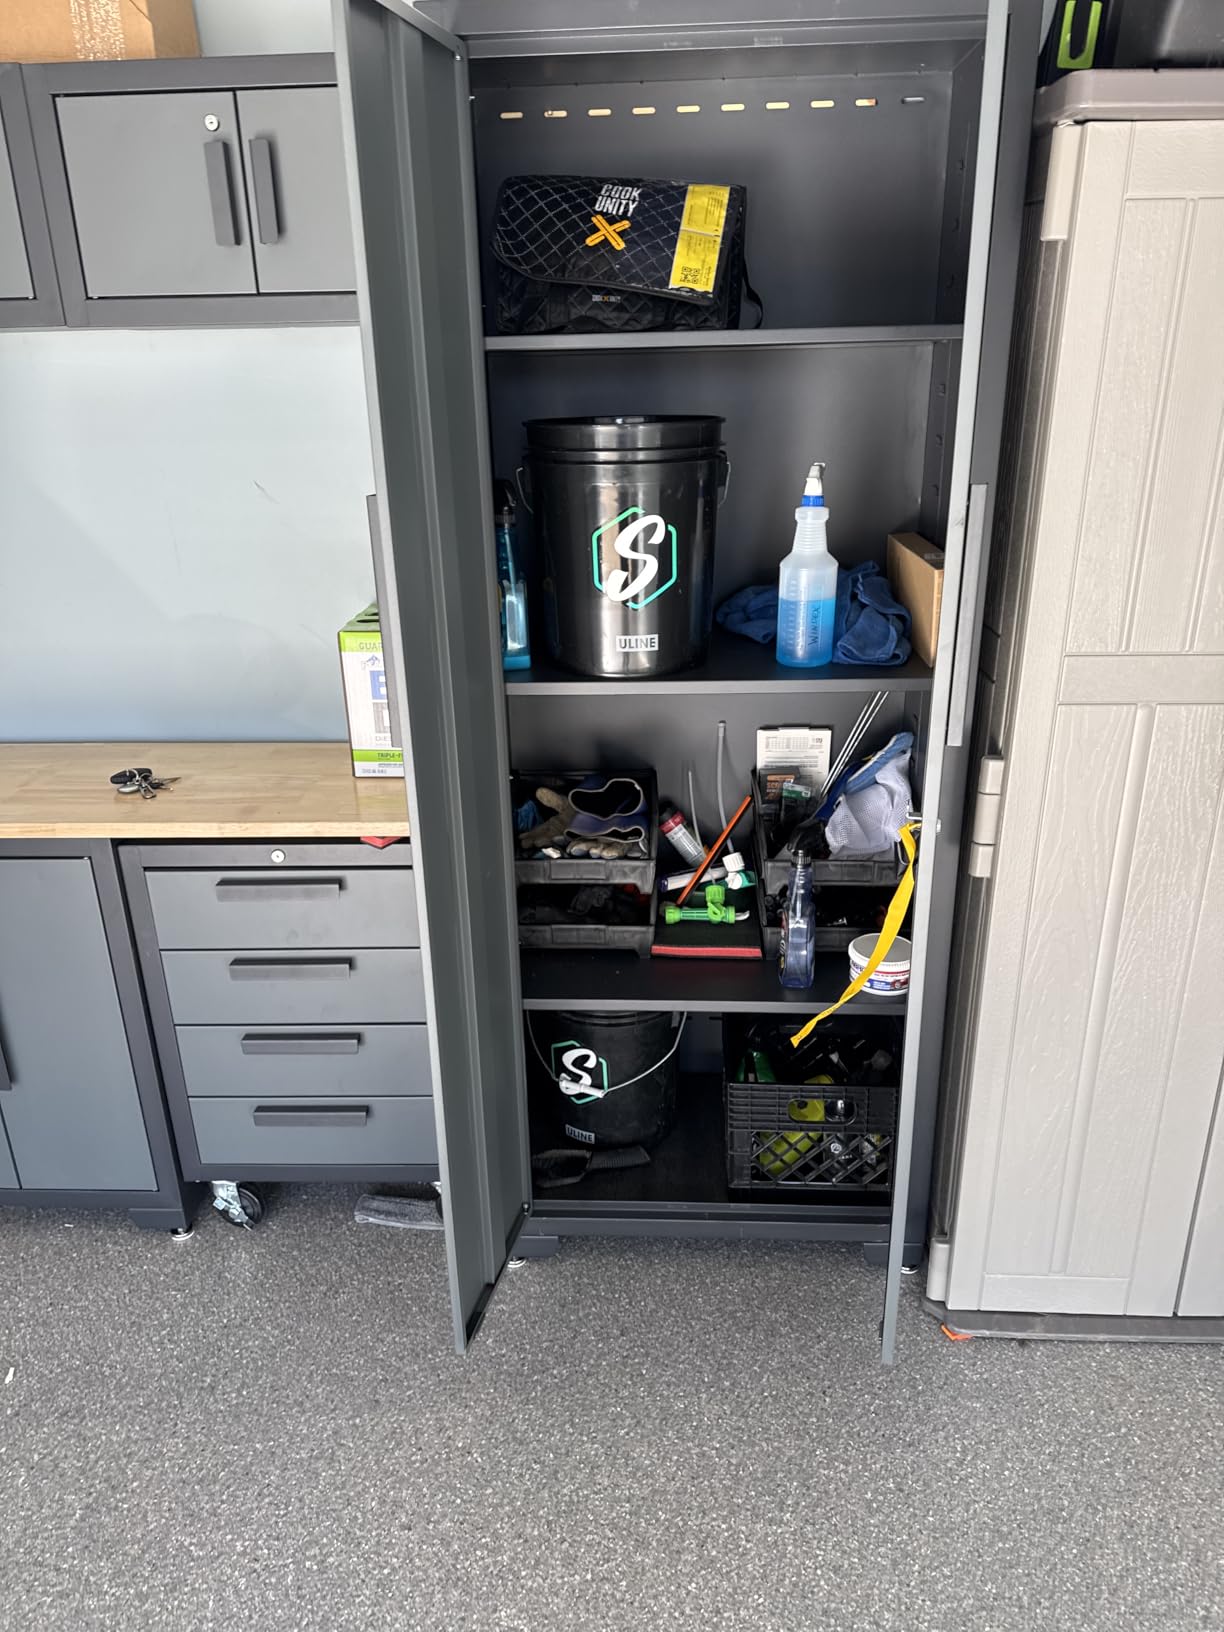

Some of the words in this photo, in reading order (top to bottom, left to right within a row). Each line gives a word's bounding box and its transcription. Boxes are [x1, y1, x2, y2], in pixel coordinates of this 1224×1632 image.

[600, 183, 642, 201] COOK
[594, 195, 639, 217] UNITY
[606, 514, 666, 602] S
[618, 637, 657, 649] ULINE
[565, 1125, 594, 1142] ULINE
